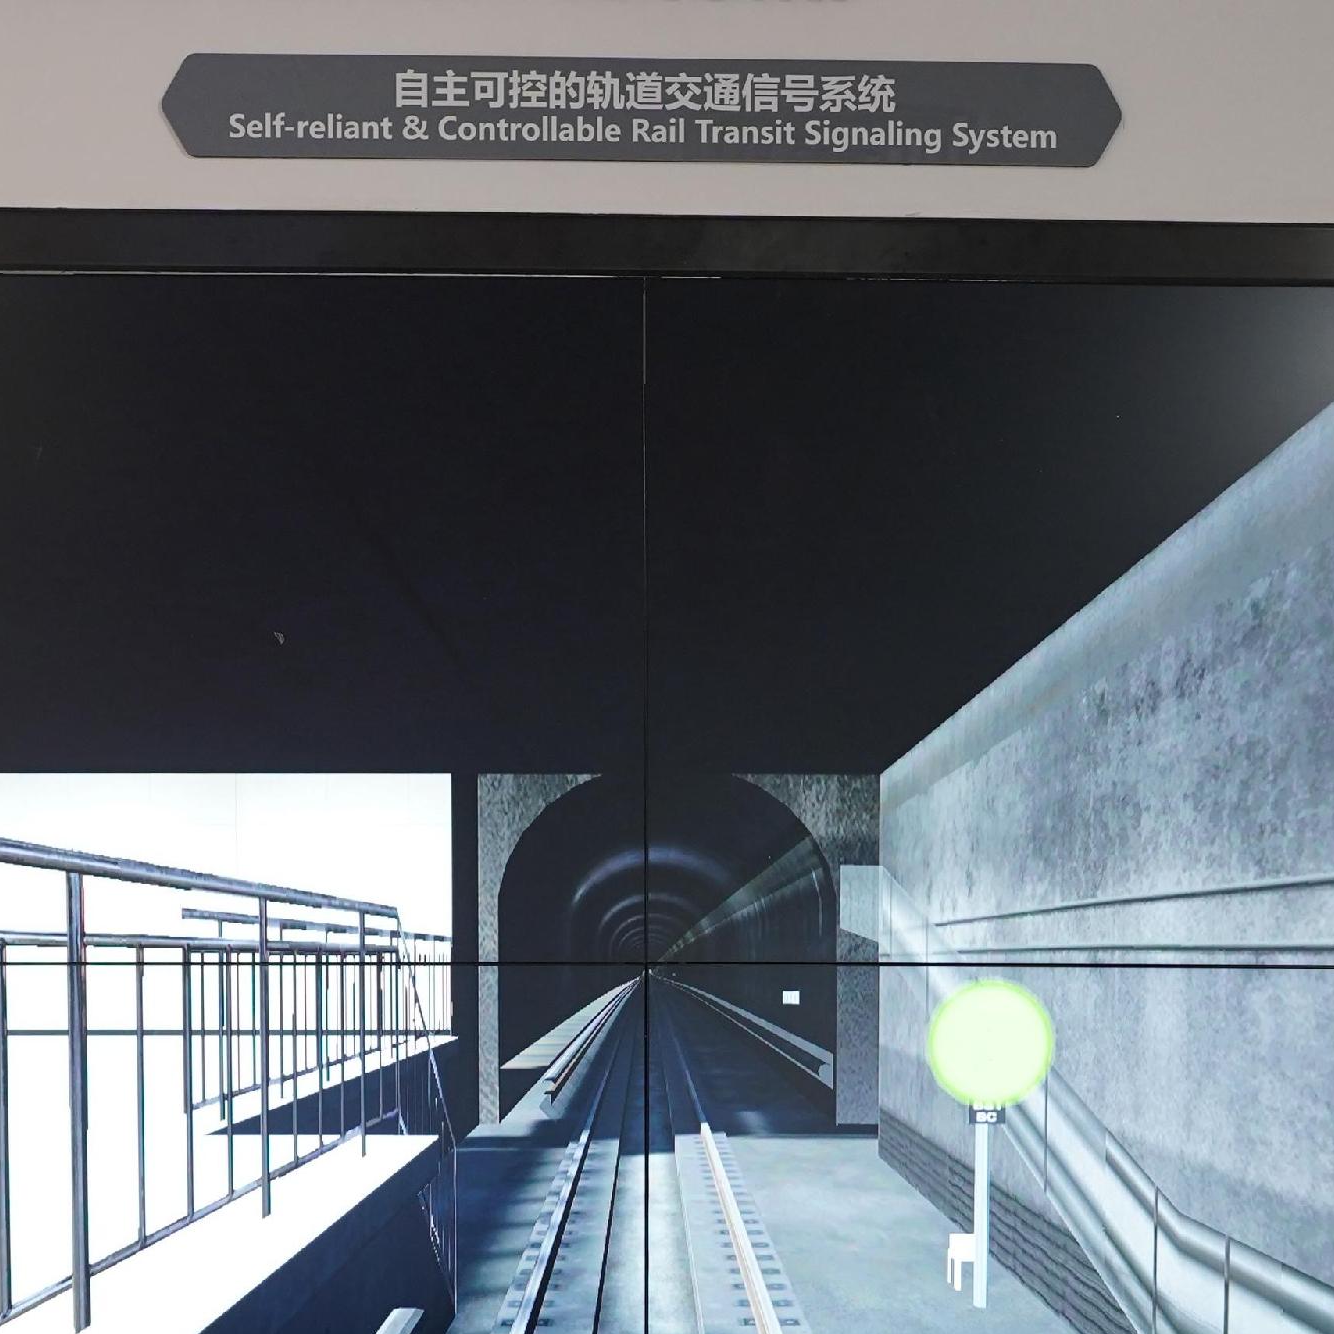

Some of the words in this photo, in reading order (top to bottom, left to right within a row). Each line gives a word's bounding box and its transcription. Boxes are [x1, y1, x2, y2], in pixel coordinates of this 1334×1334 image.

[395, 69, 896, 112] 自主可控的轨道交通信号系统
[229, 112, 393, 140] Self-reliant
[402, 116, 429, 141] &
[438, 115, 621, 143] Controllable
[633, 118, 685, 144] Rail
[695, 119, 796, 146] Transit
[804, 120, 942, 153] Signaling
[952, 122, 1057, 155] System
